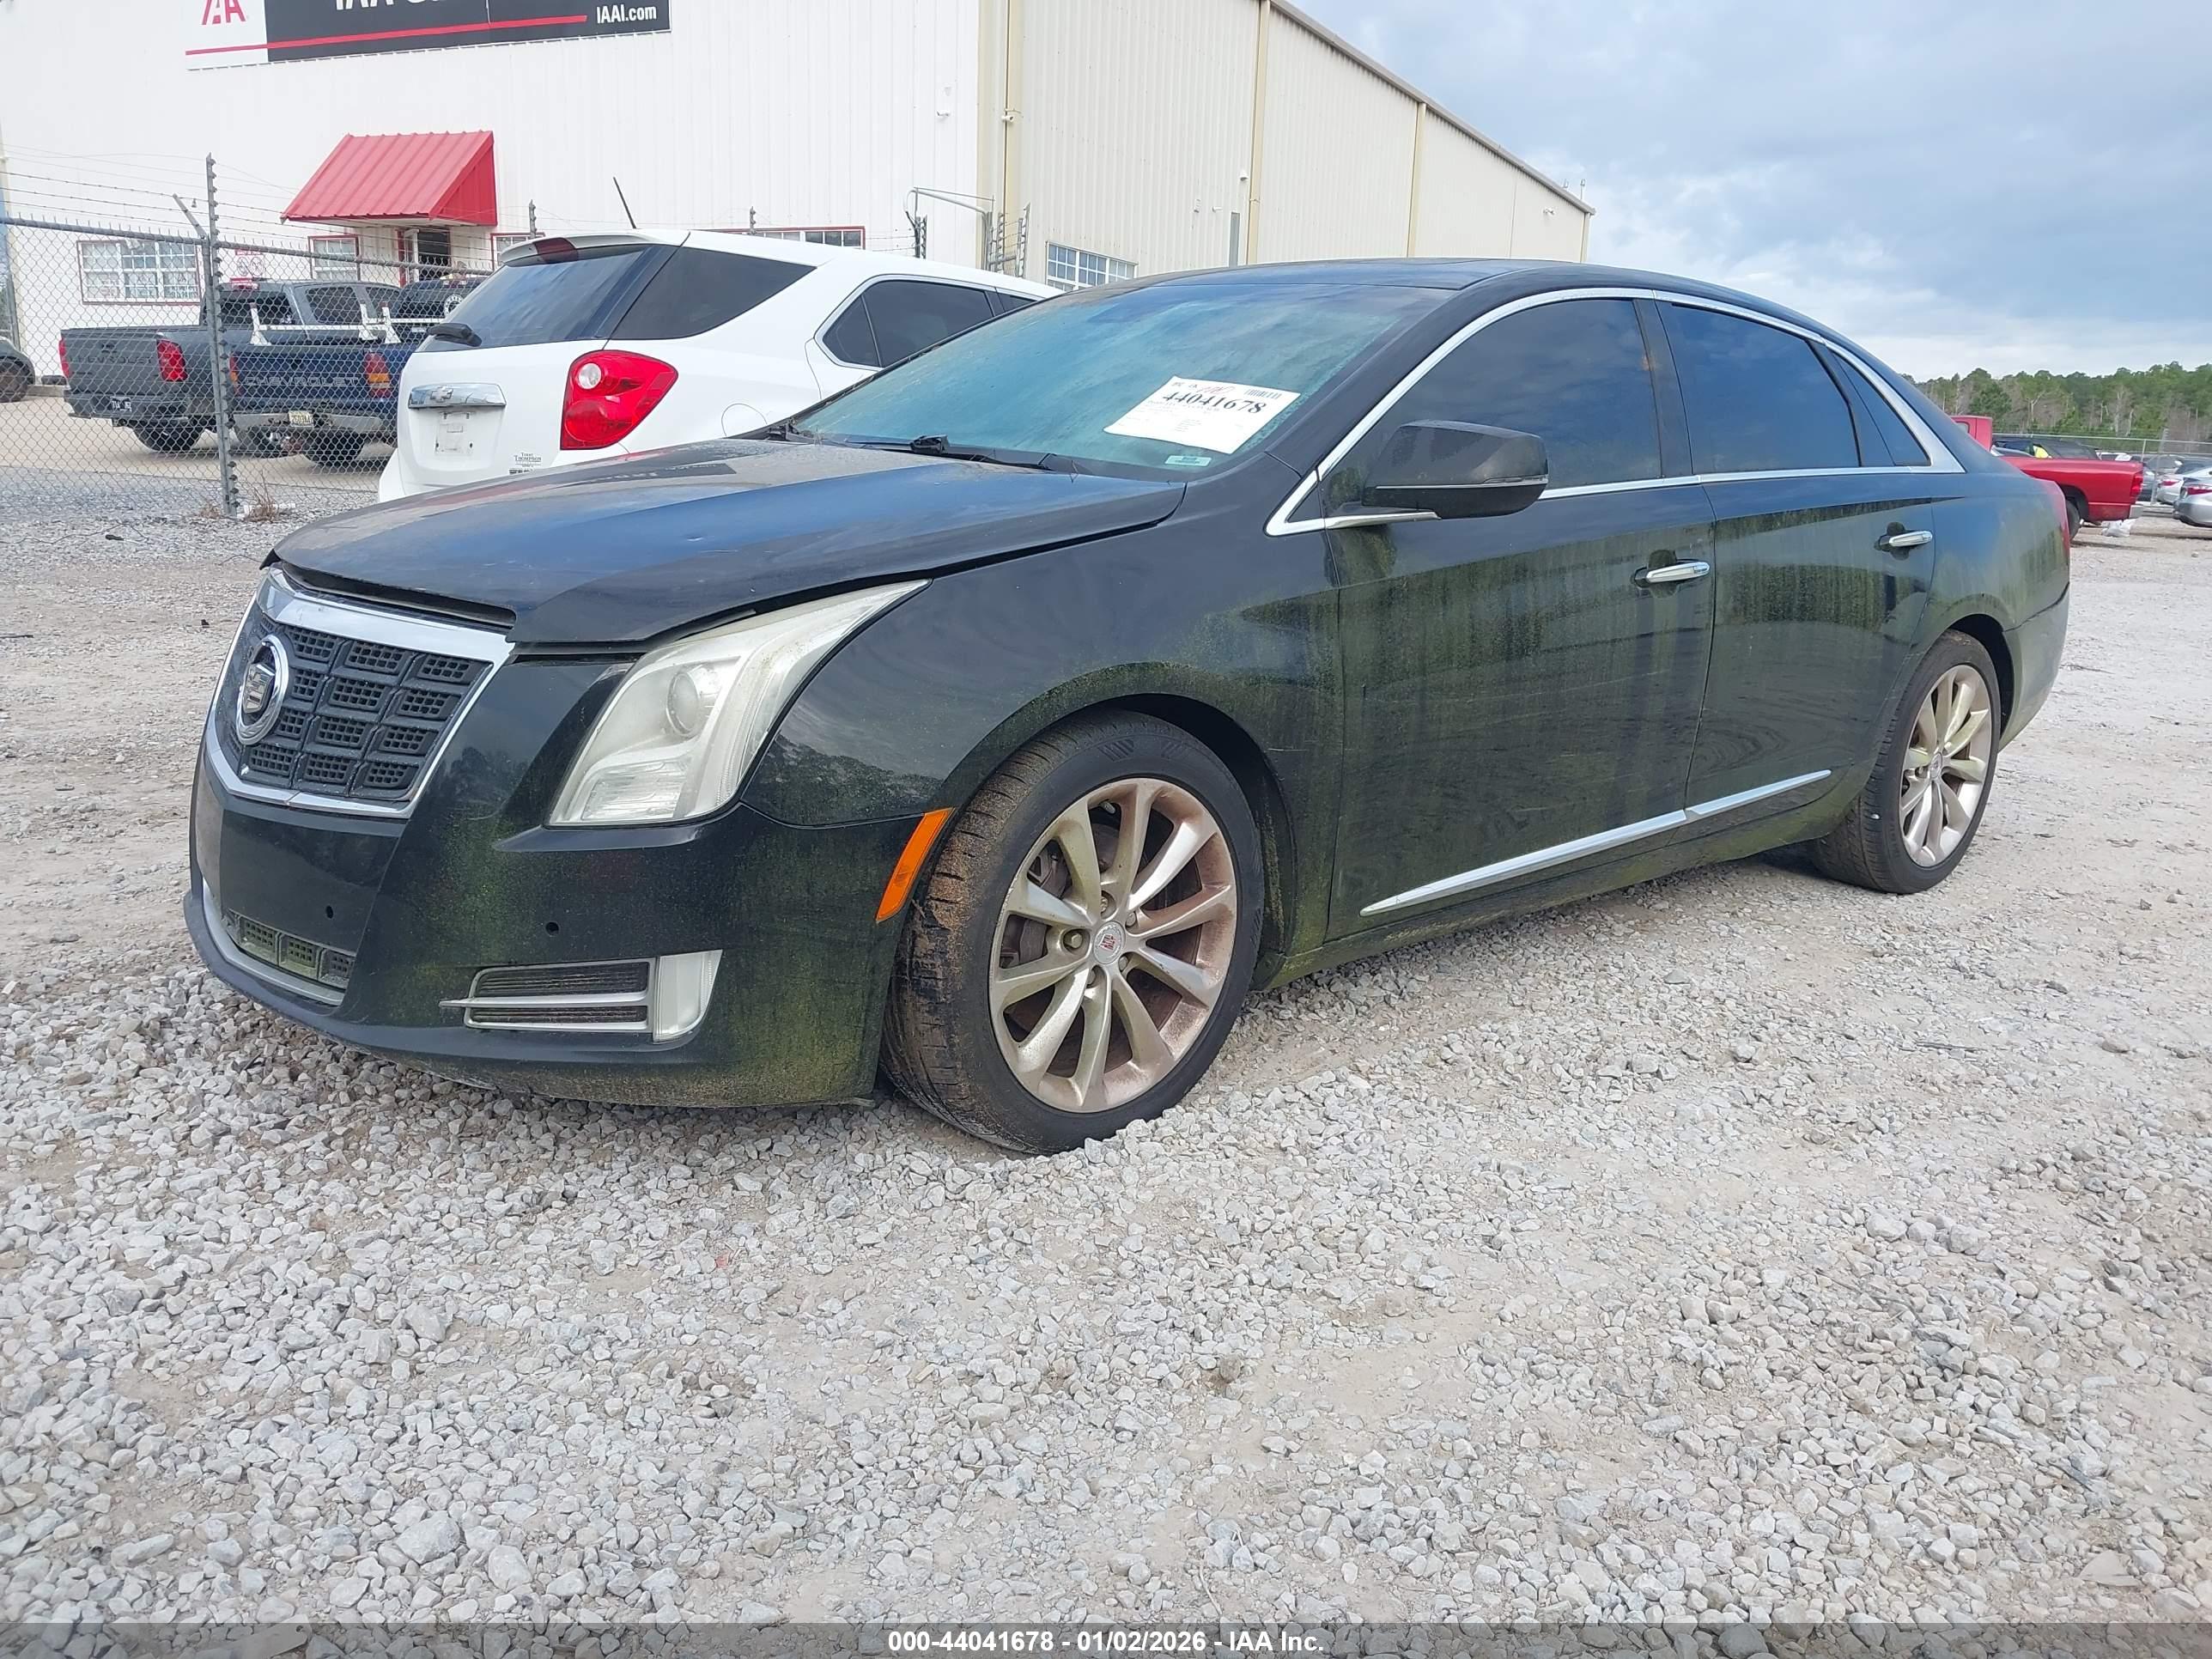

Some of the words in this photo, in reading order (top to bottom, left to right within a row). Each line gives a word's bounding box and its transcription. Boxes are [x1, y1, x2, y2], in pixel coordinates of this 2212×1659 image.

[596, 3, 657, 24] IAAI.com
[245, 376, 359, 386] CHEVROLET
[1163, 392, 1267, 414] 44041678
